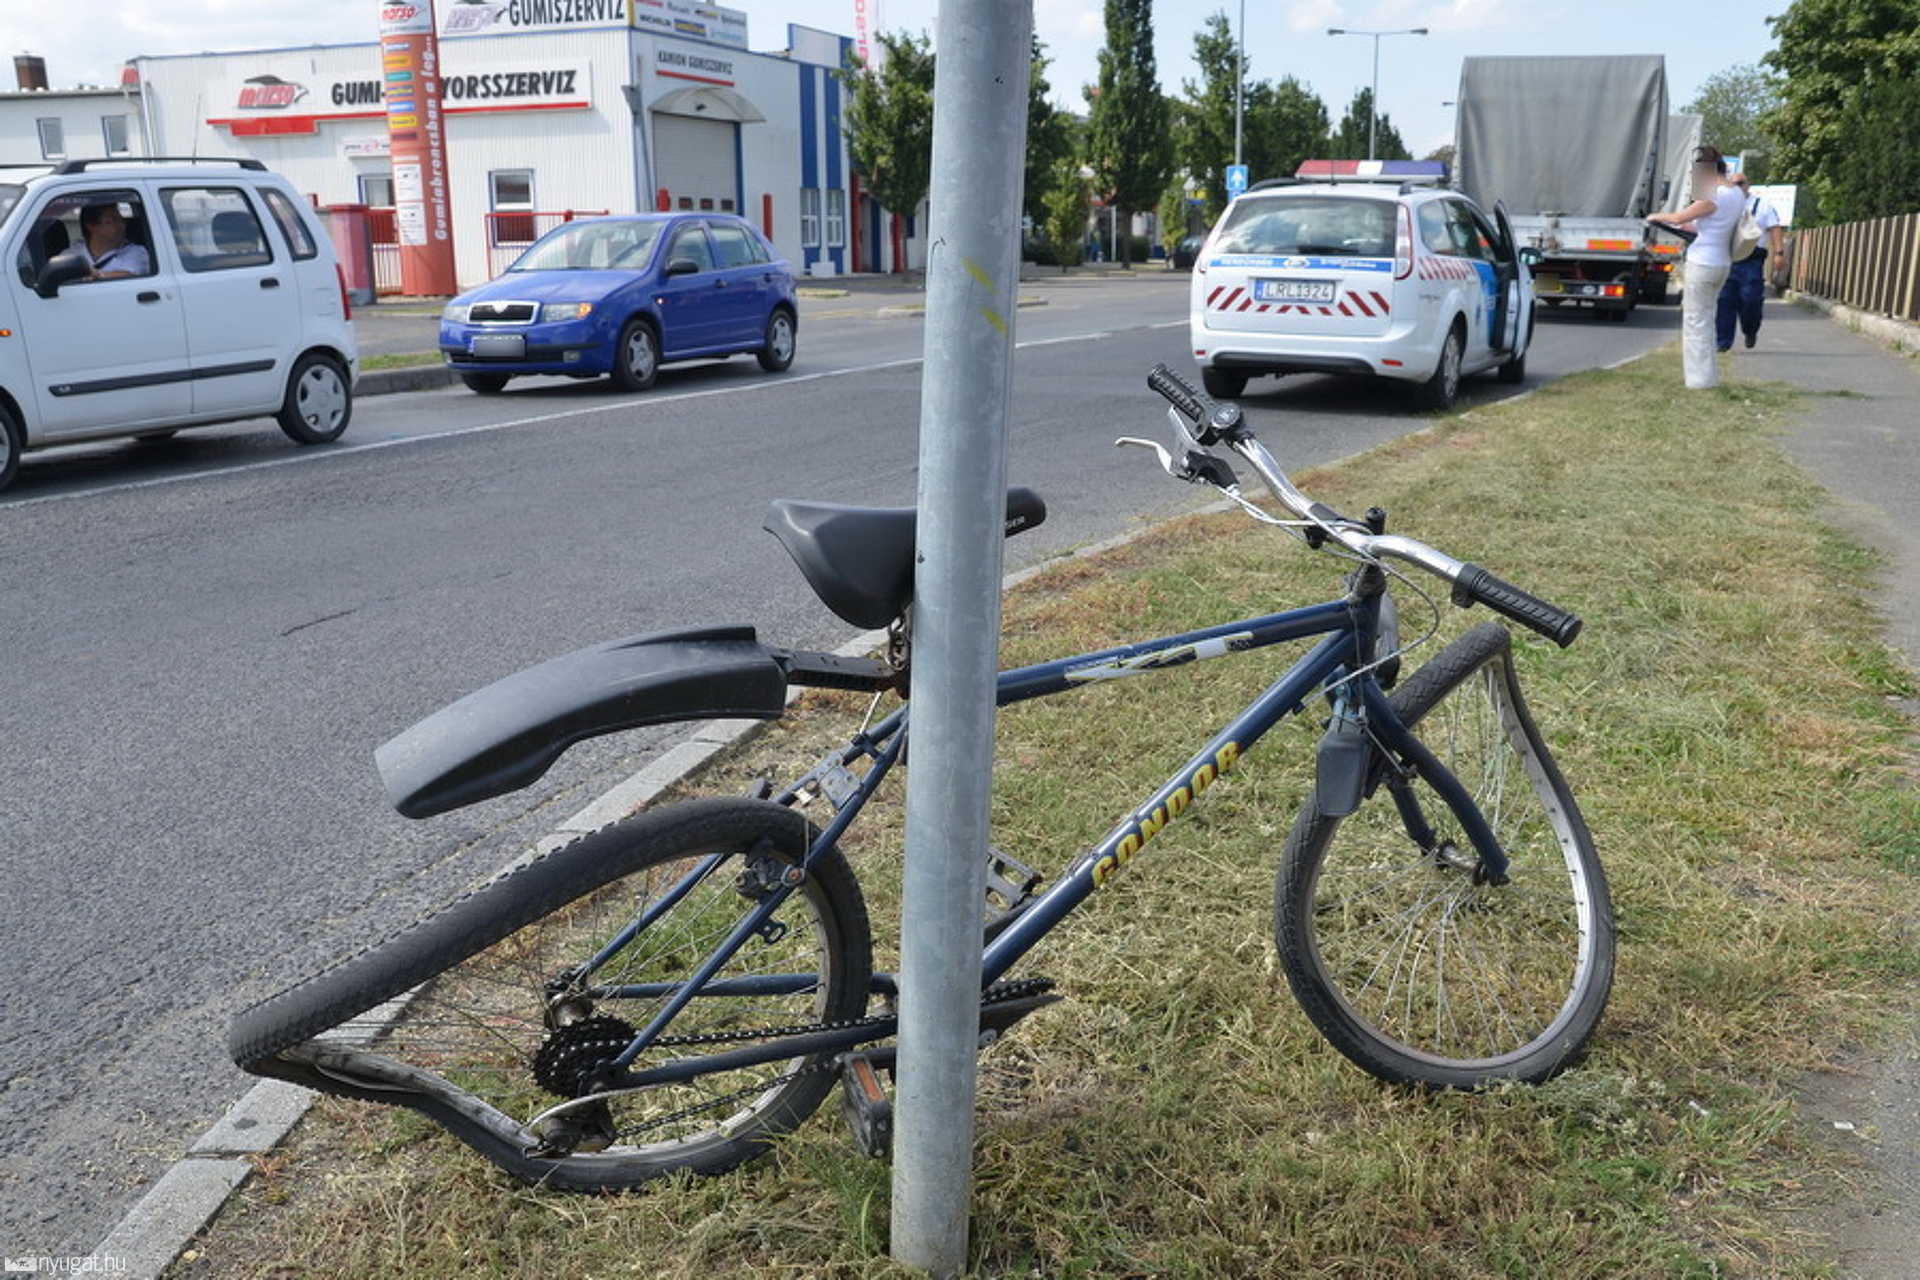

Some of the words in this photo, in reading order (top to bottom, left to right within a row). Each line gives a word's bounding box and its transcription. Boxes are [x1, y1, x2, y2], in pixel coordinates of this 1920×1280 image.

[509, 0, 625, 26] GUMISZERVIZ
[688, 55, 733, 75] GUMISZERVIZ
[238, 85, 295, 107] marso
[440, 70, 577, 100] YORSSZERVIZ
[1092, 741, 1241, 888] CONDOR
